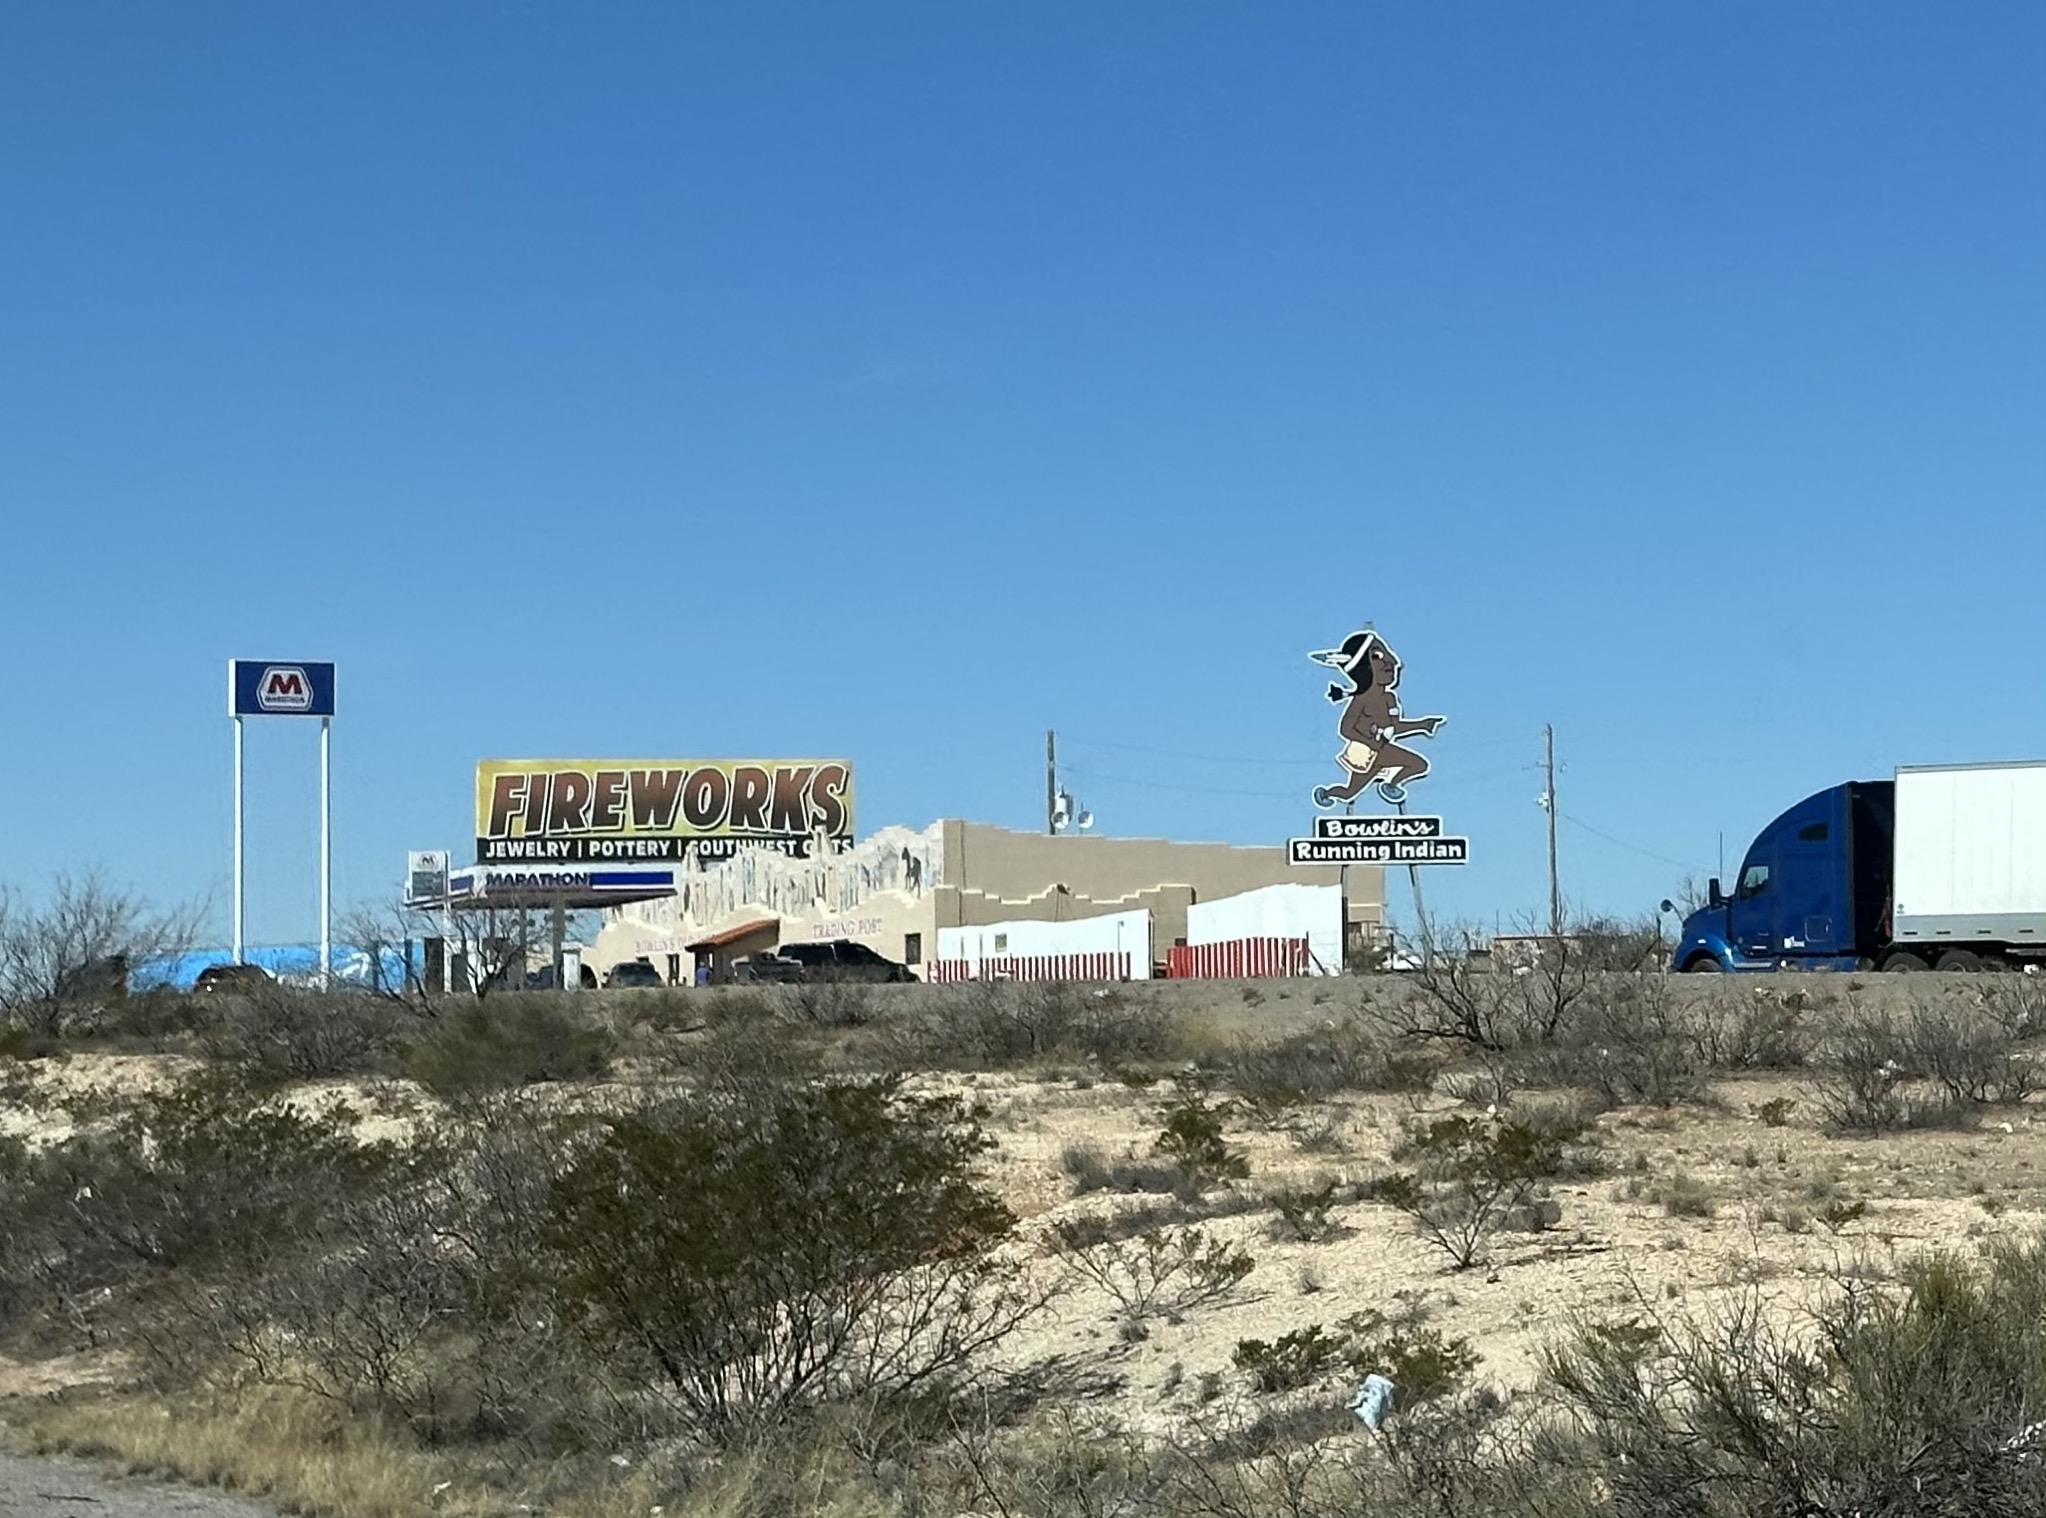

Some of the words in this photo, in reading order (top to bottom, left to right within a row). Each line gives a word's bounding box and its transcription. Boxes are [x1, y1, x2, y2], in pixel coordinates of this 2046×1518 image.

[268, 674, 302, 694] M
[486, 764, 850, 840] FIREWORKS
[1326, 819, 1435, 837] Bowlin's
[486, 840, 571, 858] JEWELRY
[589, 840, 671, 857] POTTERY
[802, 839, 852, 856] GTS
[1296, 842, 1390, 861] Running
[1395, 841, 1462, 859] Indian
[486, 872, 589, 887] MARATHON
